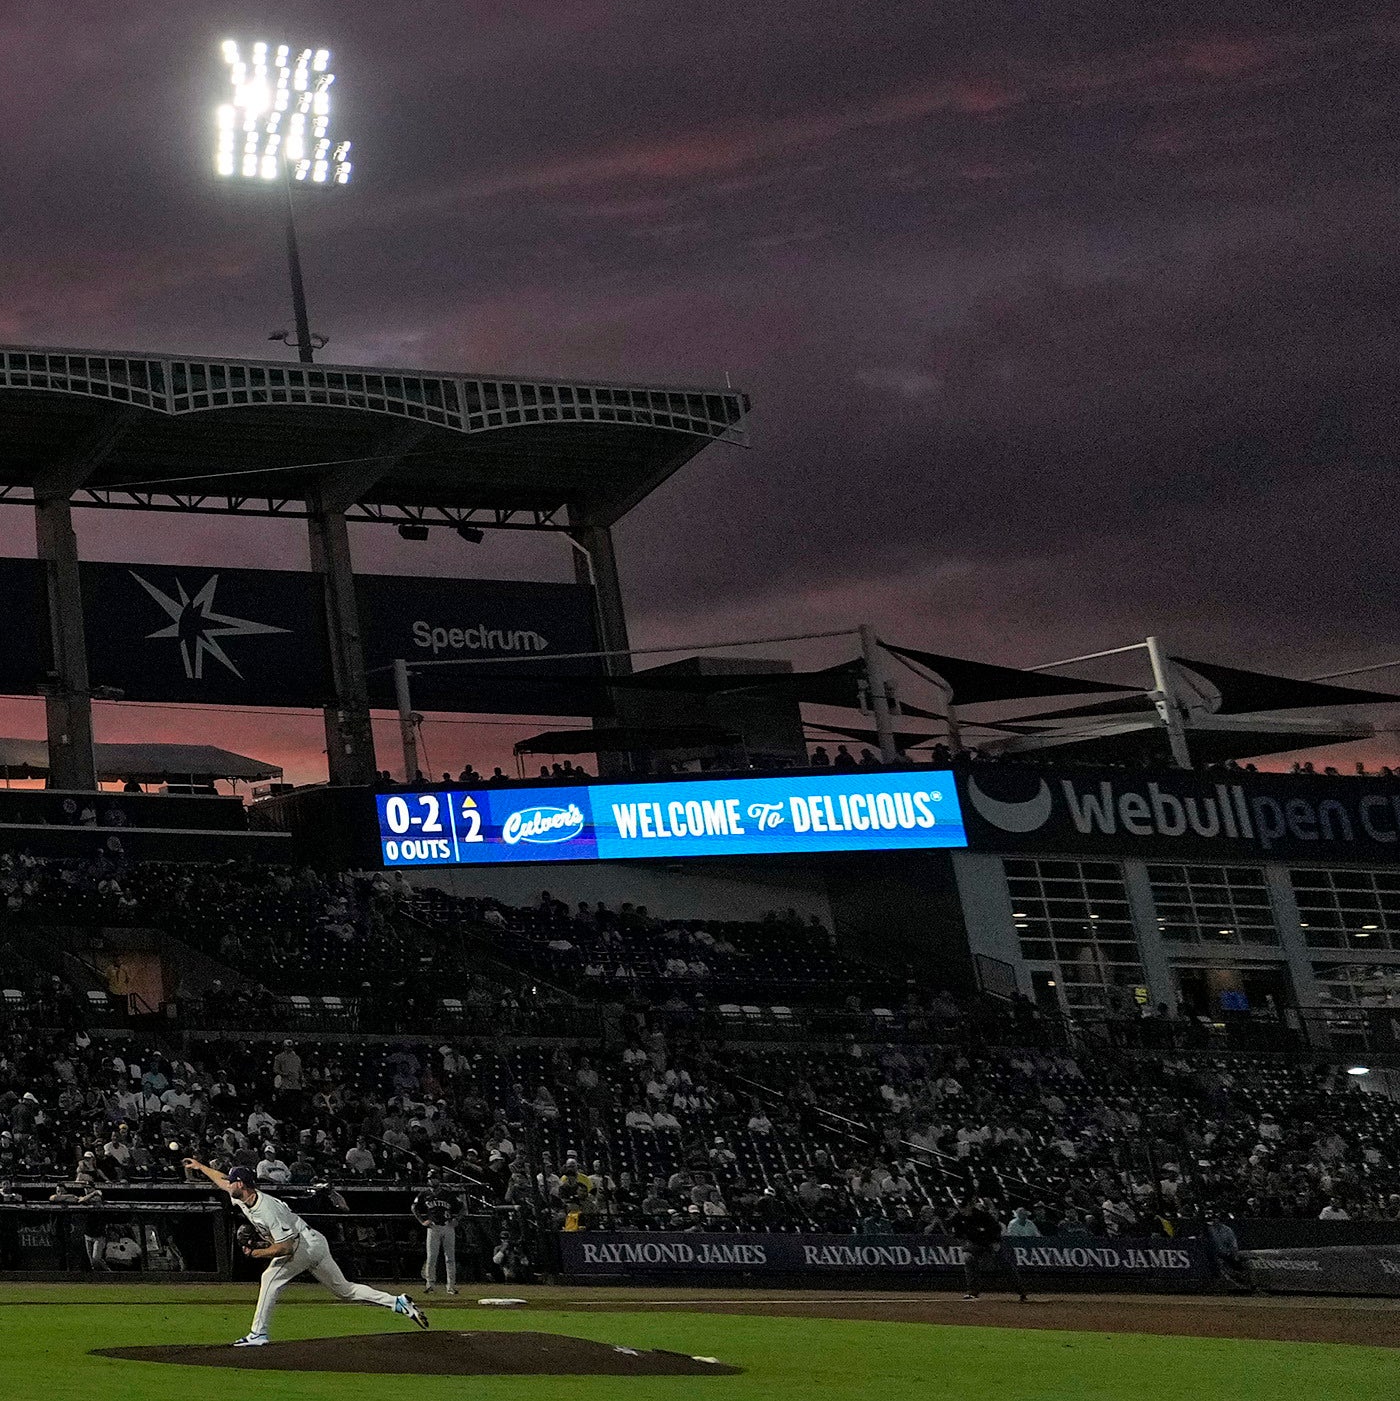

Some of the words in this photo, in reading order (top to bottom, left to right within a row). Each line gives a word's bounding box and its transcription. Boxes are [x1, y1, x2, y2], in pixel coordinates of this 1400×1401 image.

[412, 620, 546, 655] Spectrum
[386, 795, 443, 834] 0-2
[462, 810, 484, 843] 2
[502, 804, 584, 845] Culver's
[612, 799, 745, 839] WELCOME
[748, 802, 785, 832] To
[386, 841, 399, 860] 0
[401, 839, 451, 860] OUTS
[582, 1243, 694, 1264] RAYMOND
[696, 1243, 767, 1264] JAMES
[803, 1245, 911, 1266] RAYMOND
[1013, 1246, 1120, 1268] RAYMOND
[1122, 1248, 1191, 1269] JAMES
